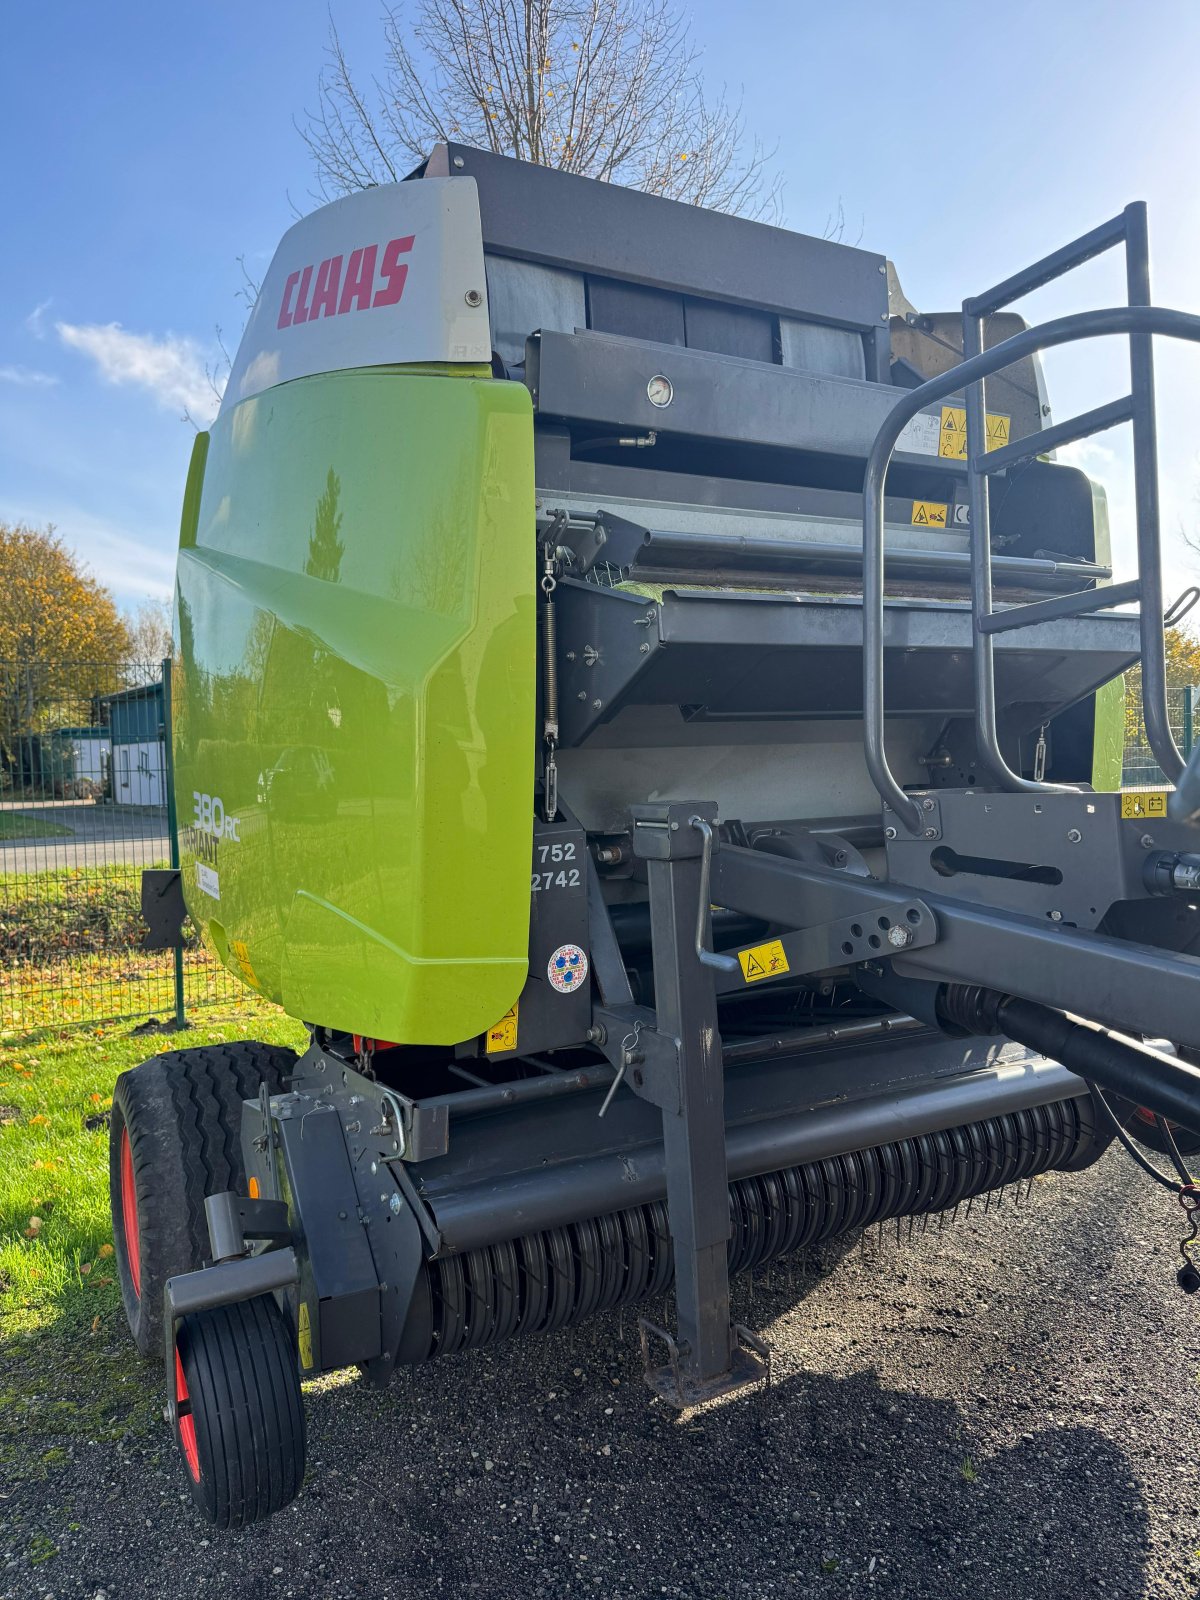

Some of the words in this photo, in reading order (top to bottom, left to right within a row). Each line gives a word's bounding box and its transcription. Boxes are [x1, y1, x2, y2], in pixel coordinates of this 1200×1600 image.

[277, 235, 416, 330] CLAAS
[537, 842, 576, 863] 752
[531, 868, 581, 892] 2742
